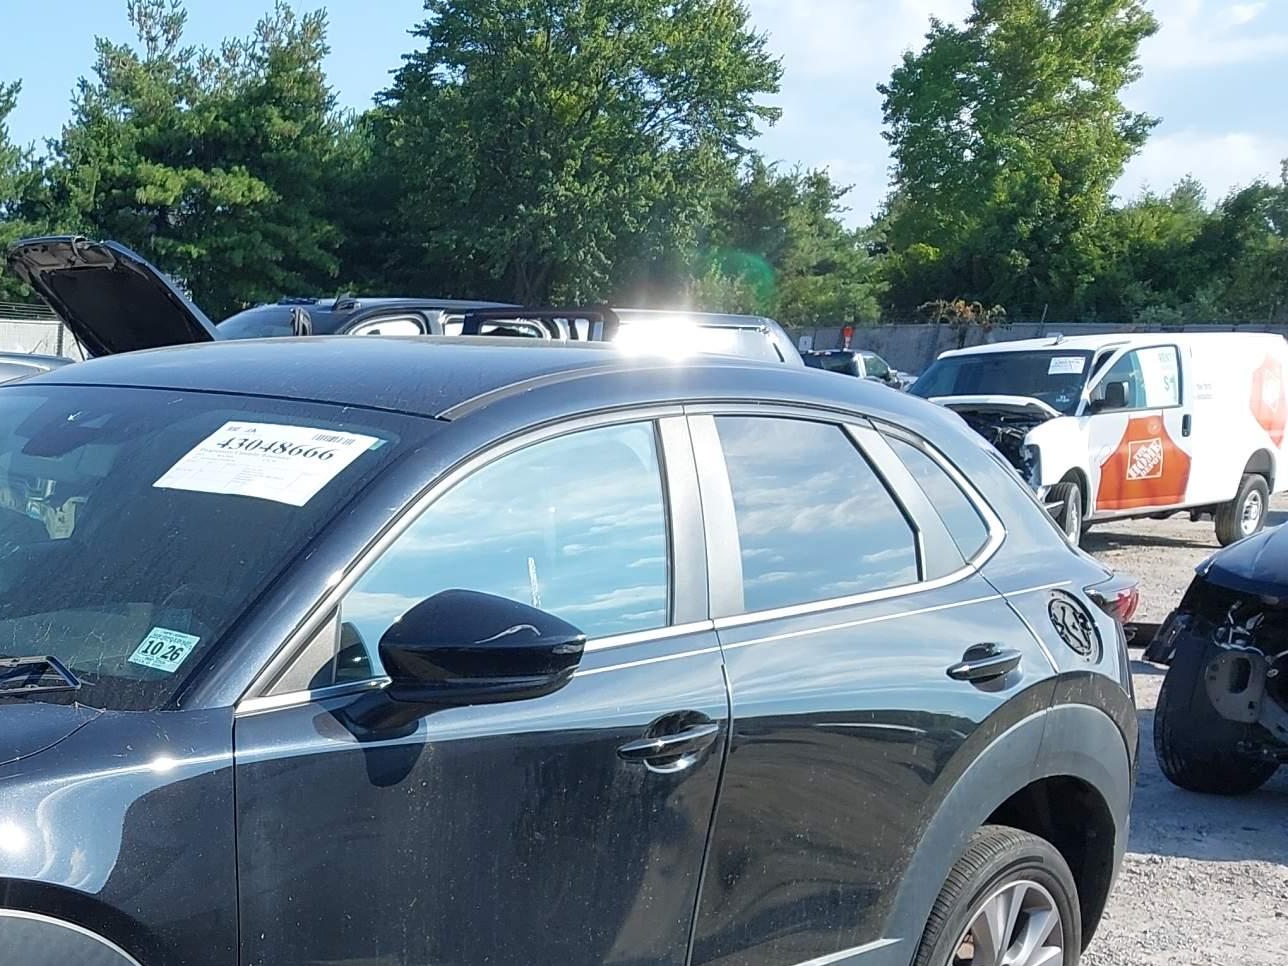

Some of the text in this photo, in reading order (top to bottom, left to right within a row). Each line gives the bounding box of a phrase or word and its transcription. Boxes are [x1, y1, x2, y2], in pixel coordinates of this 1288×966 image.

[216, 436, 335, 462] 43048666
[142, 639, 165, 656] 10
[161, 645, 184, 661] 26
